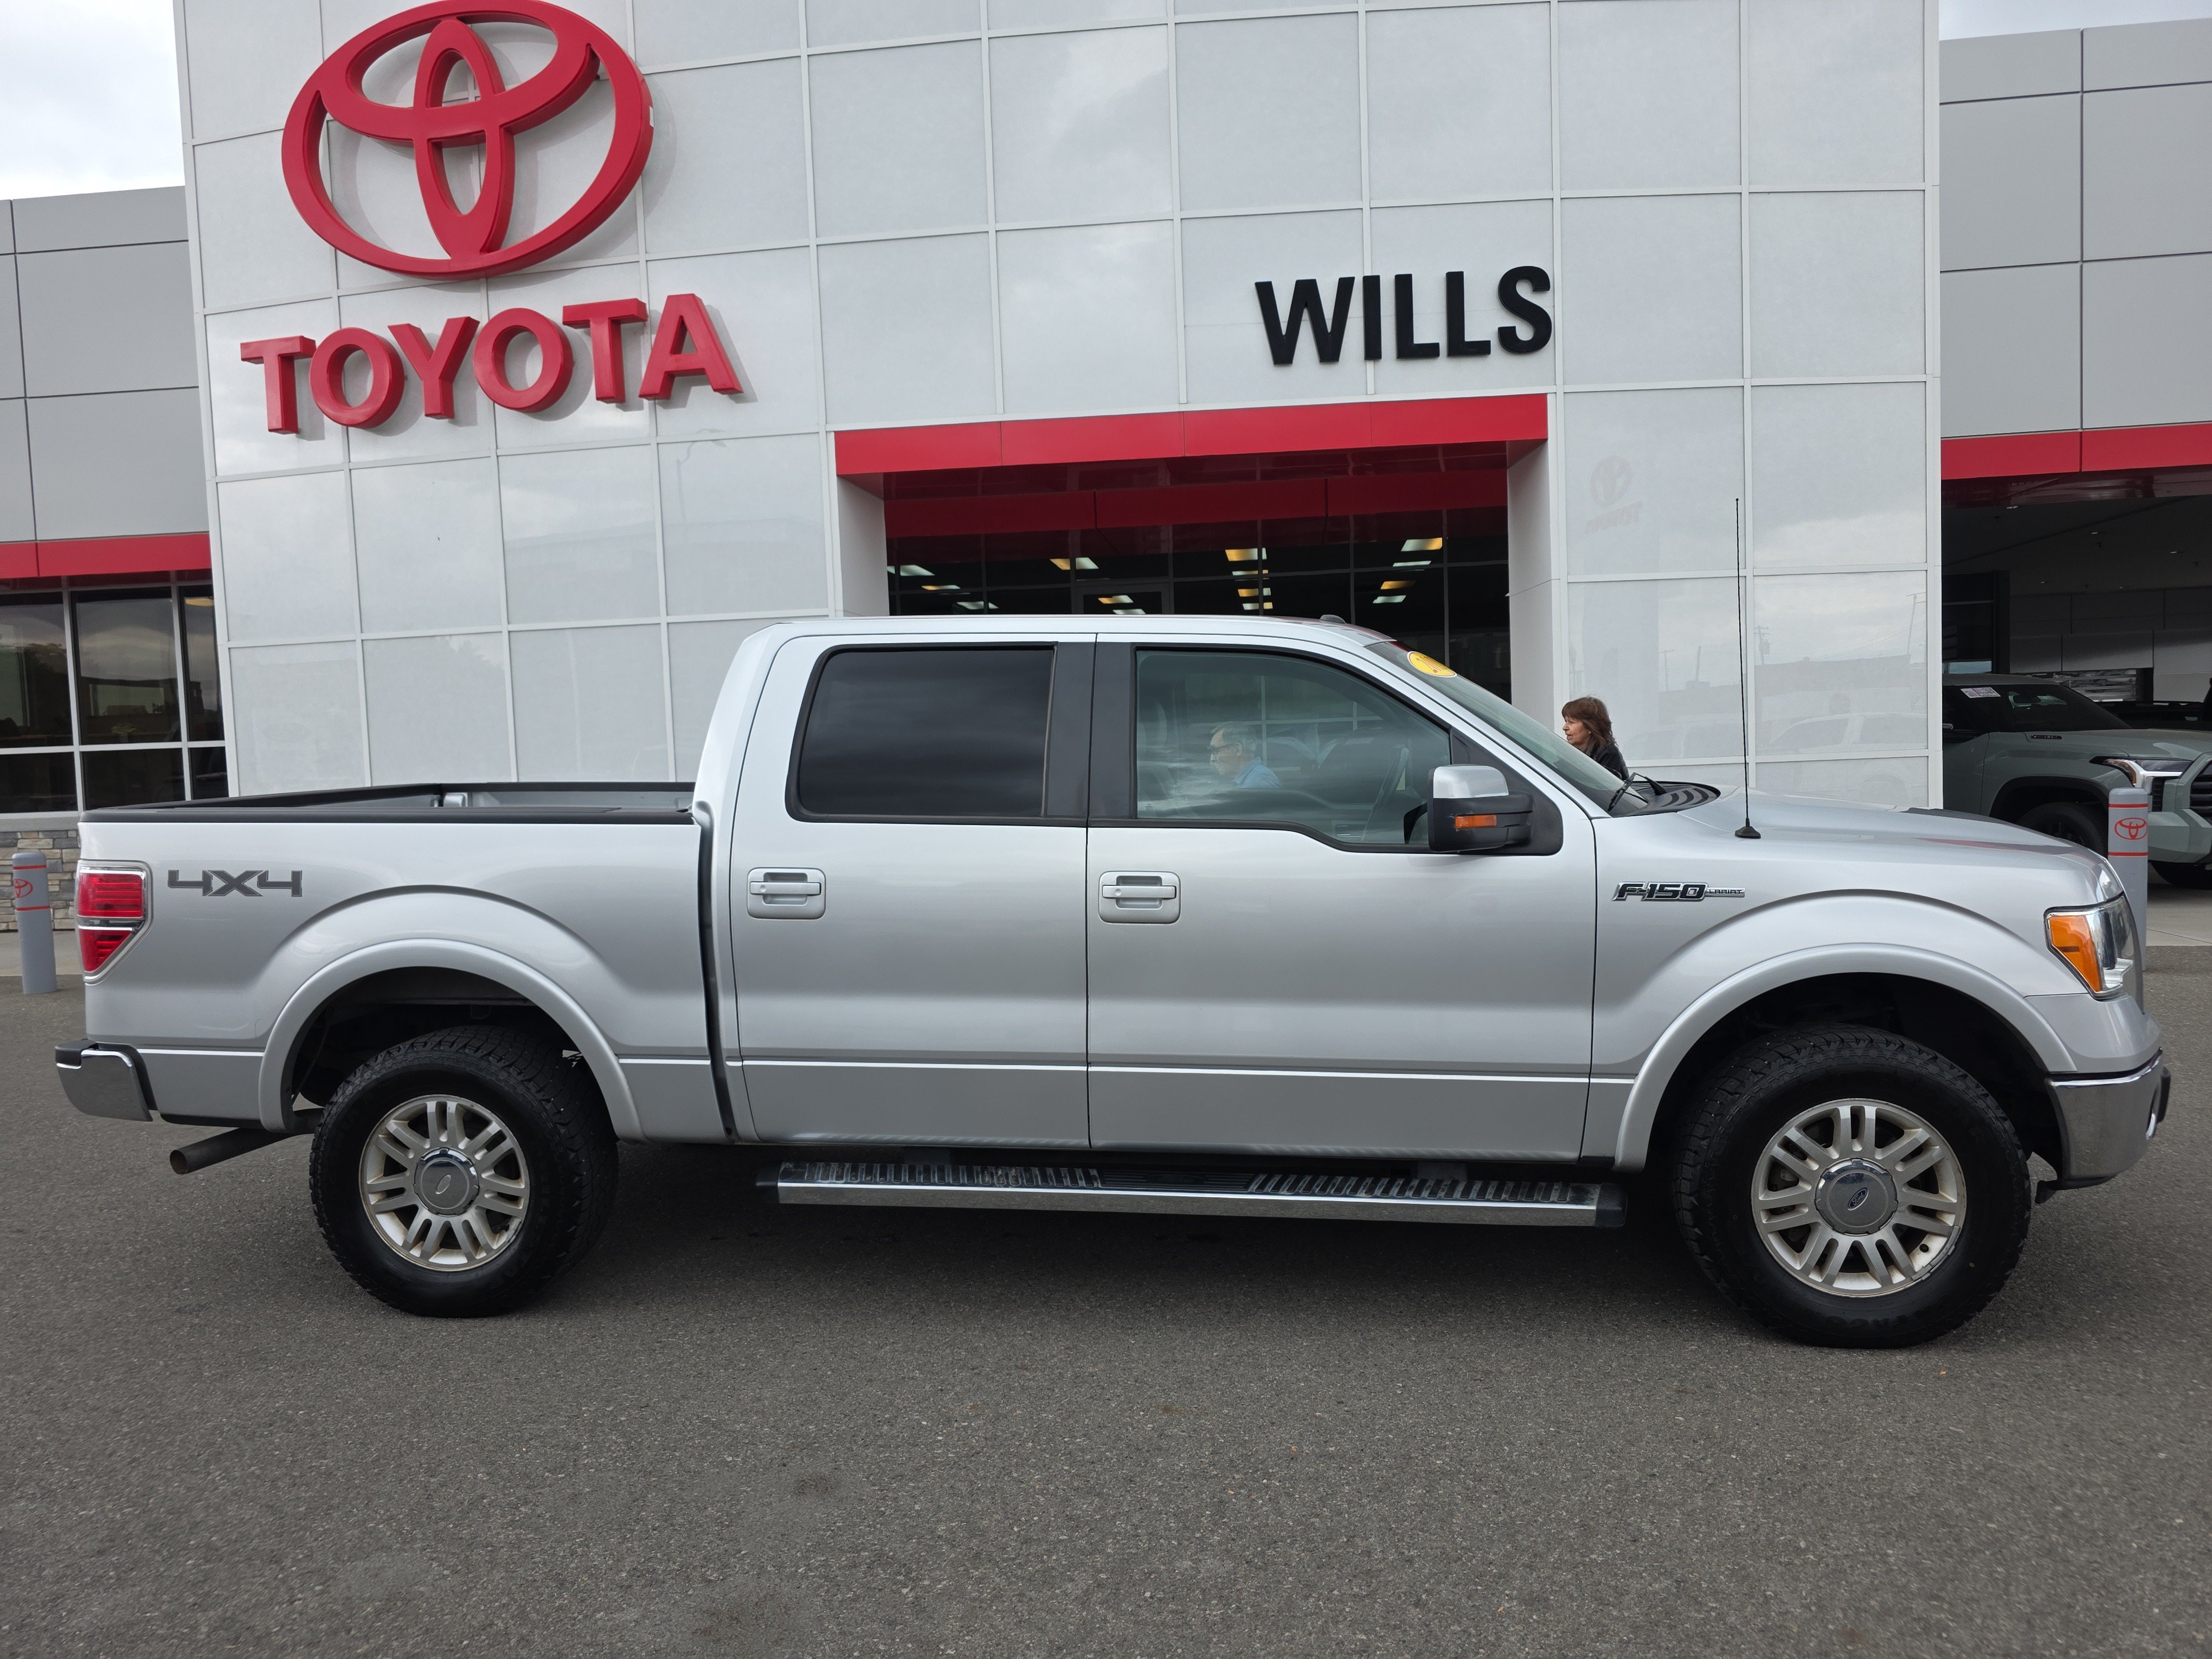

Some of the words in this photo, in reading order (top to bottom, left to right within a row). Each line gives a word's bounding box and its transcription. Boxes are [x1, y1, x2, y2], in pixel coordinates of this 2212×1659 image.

[1255, 266, 1552, 365] WILLS
[240, 293, 743, 435] TOYOTA
[168, 870, 302, 897] 4X4
[1612, 882, 1709, 902] F-150
